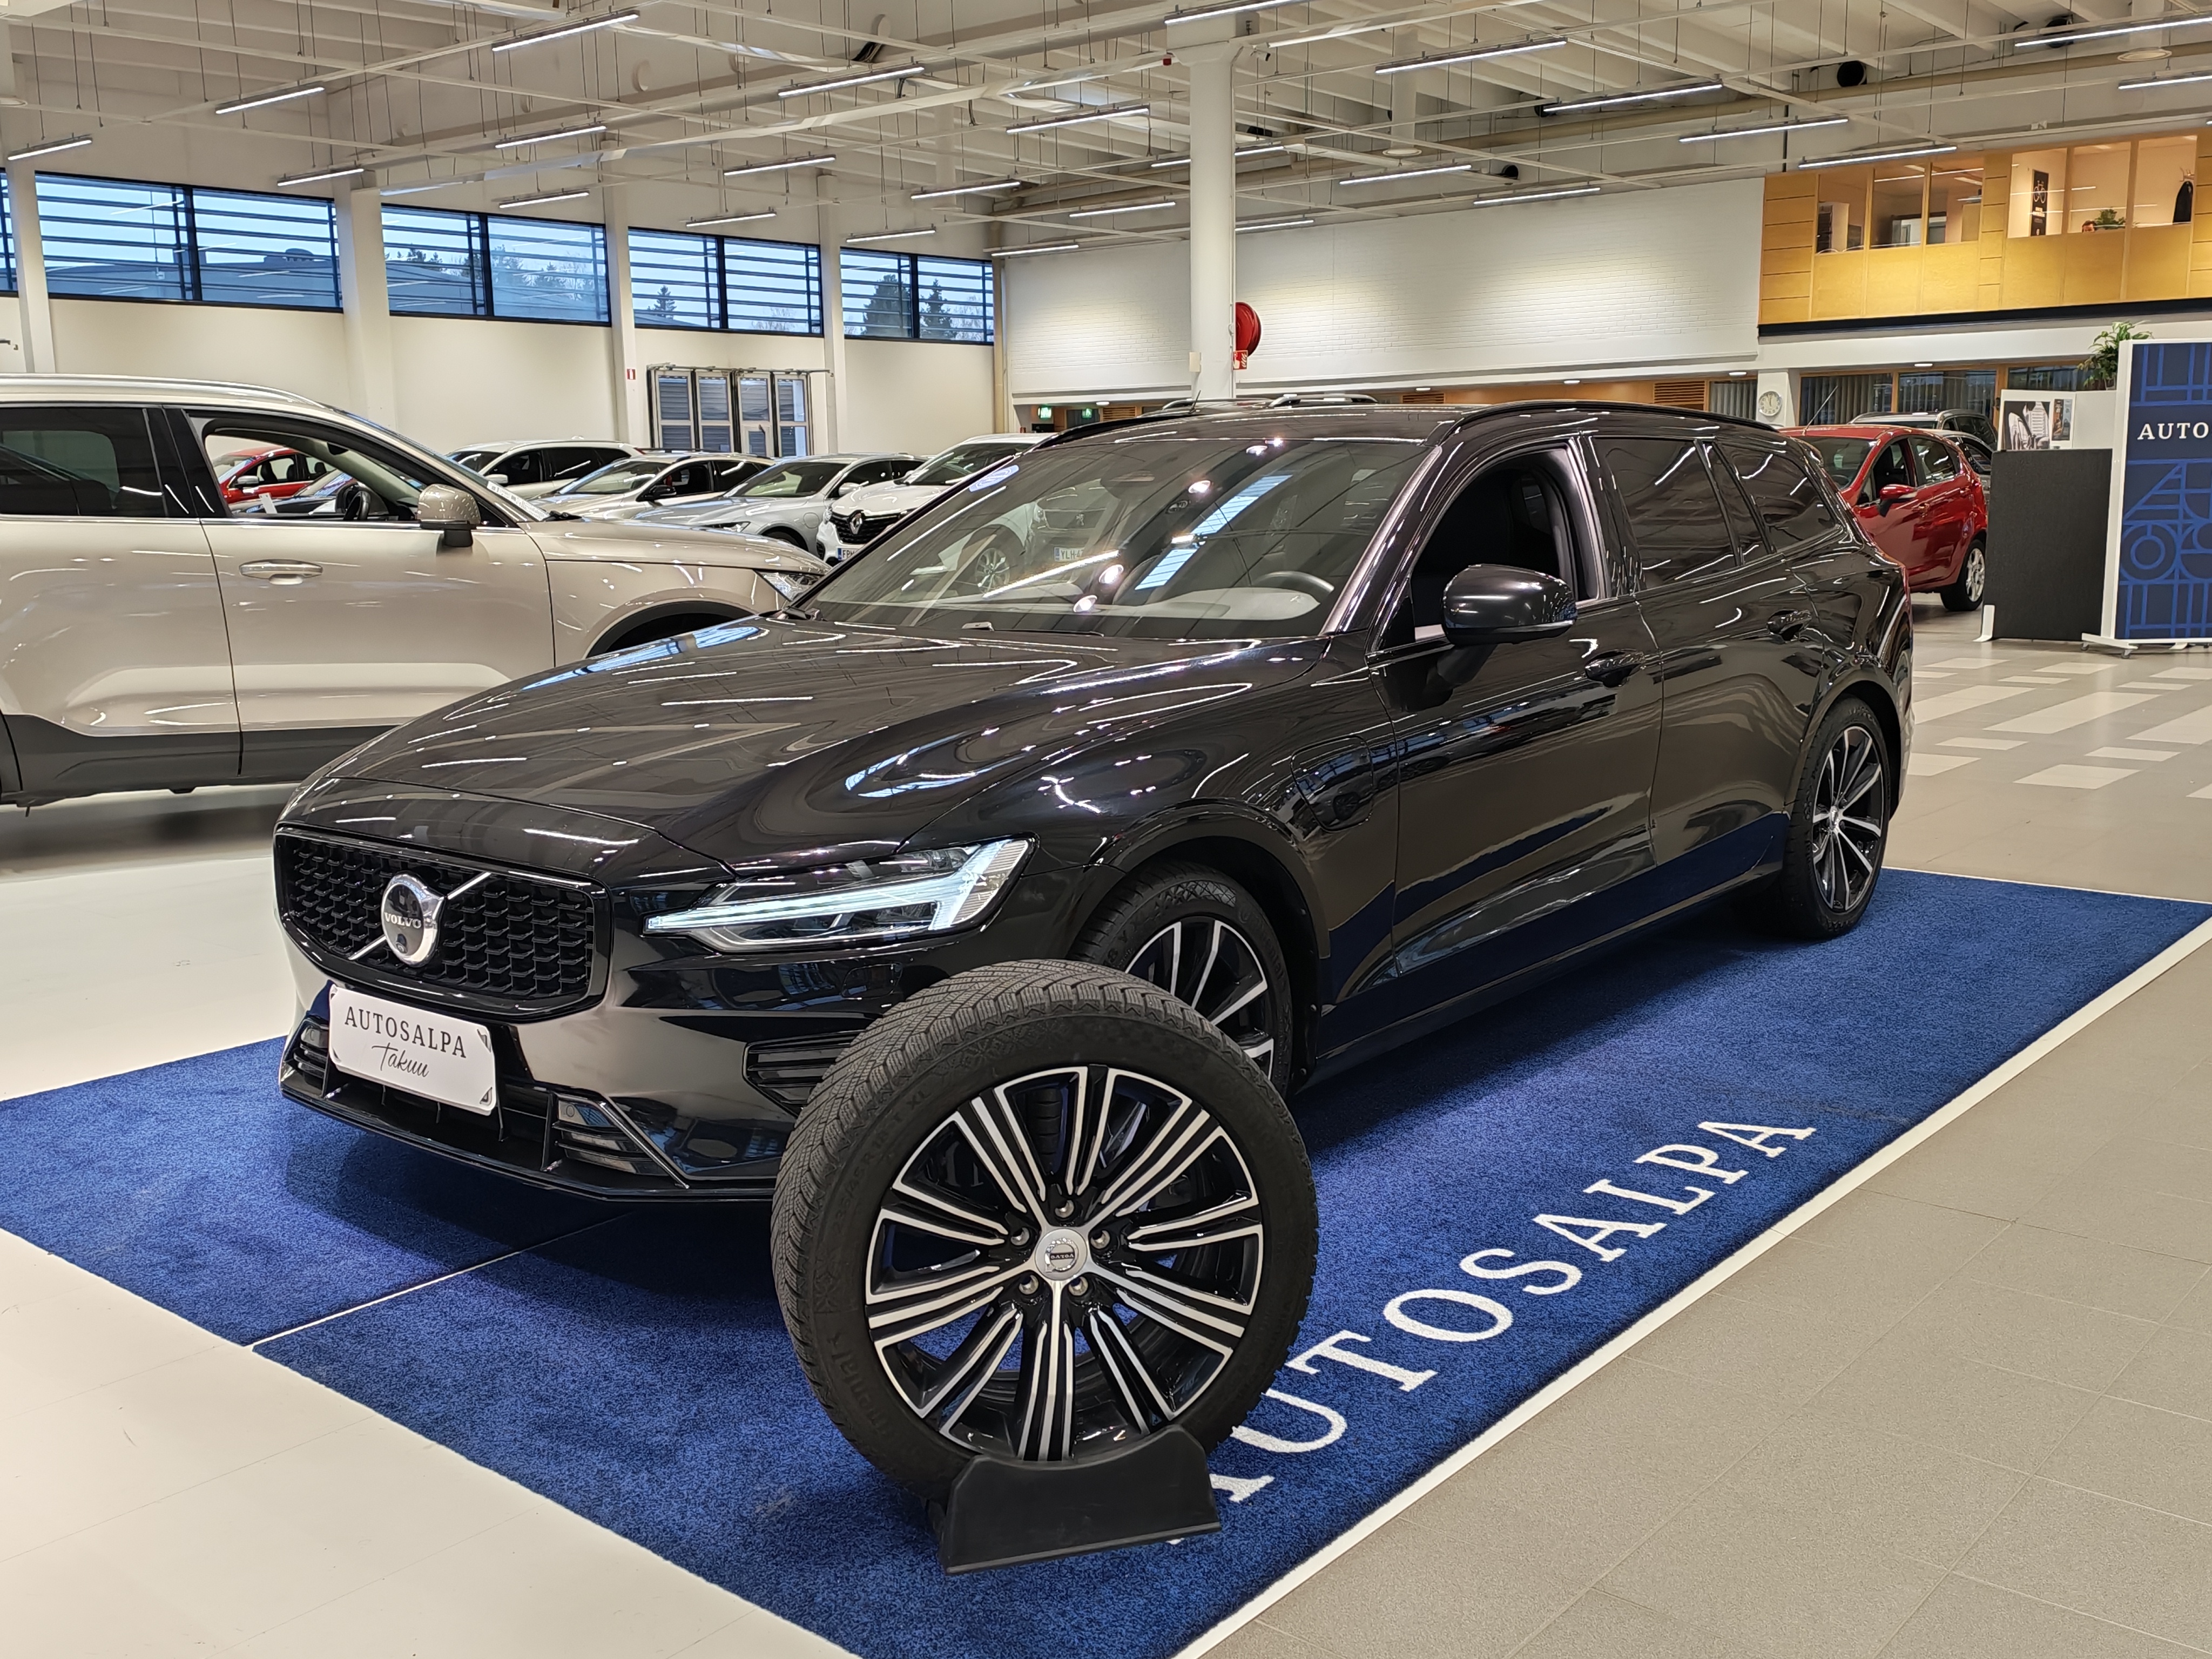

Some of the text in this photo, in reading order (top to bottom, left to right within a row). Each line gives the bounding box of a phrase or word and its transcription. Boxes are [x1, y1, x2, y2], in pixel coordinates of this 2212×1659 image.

[2137, 422, 2212, 440] AUTO
[385, 912, 421, 929] VOLVO
[344, 1006, 467, 1058] AUTOSALPA
[371, 1042, 429, 1077] Takuu
[906, 1090, 932, 1110] XL
